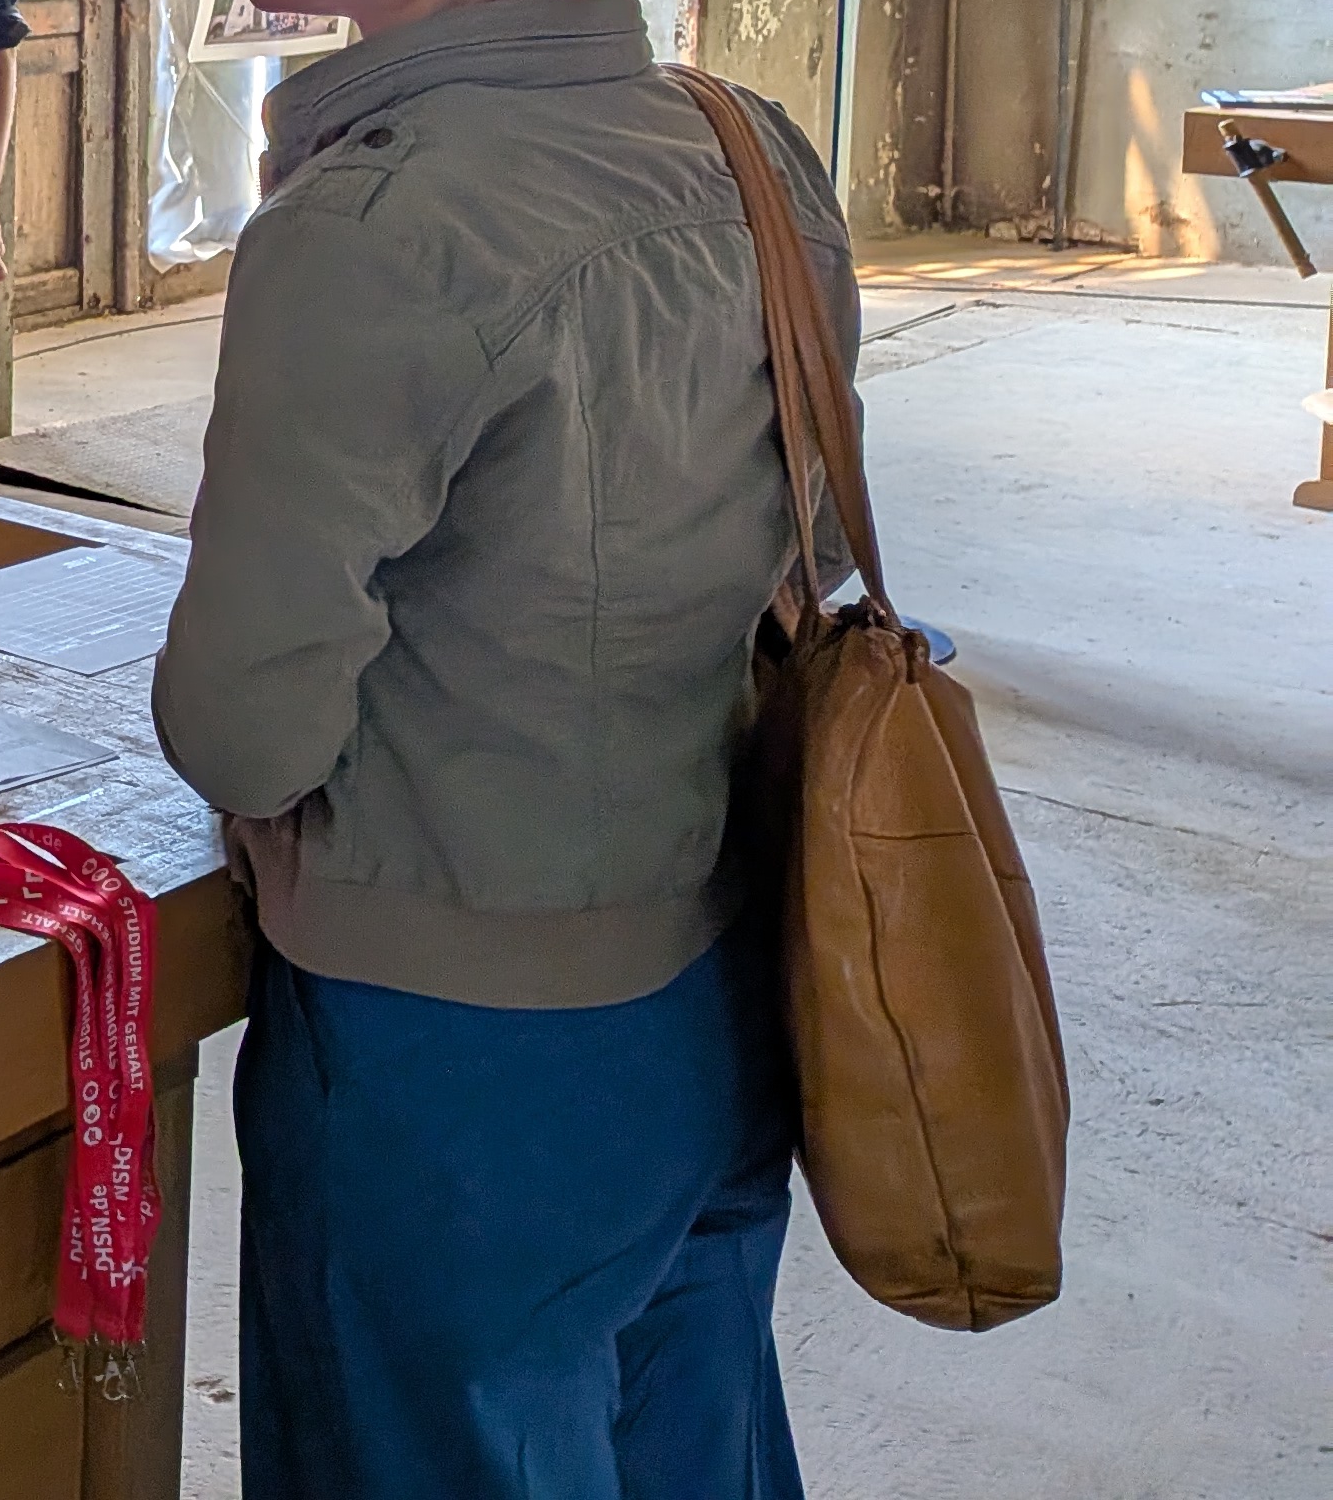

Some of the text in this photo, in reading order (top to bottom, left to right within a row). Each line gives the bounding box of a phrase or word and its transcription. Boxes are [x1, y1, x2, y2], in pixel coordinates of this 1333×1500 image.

[117, 896, 144, 1095] STUDIUM MIT GEHALT.
[90, 1184, 115, 1272] DHSN.de
